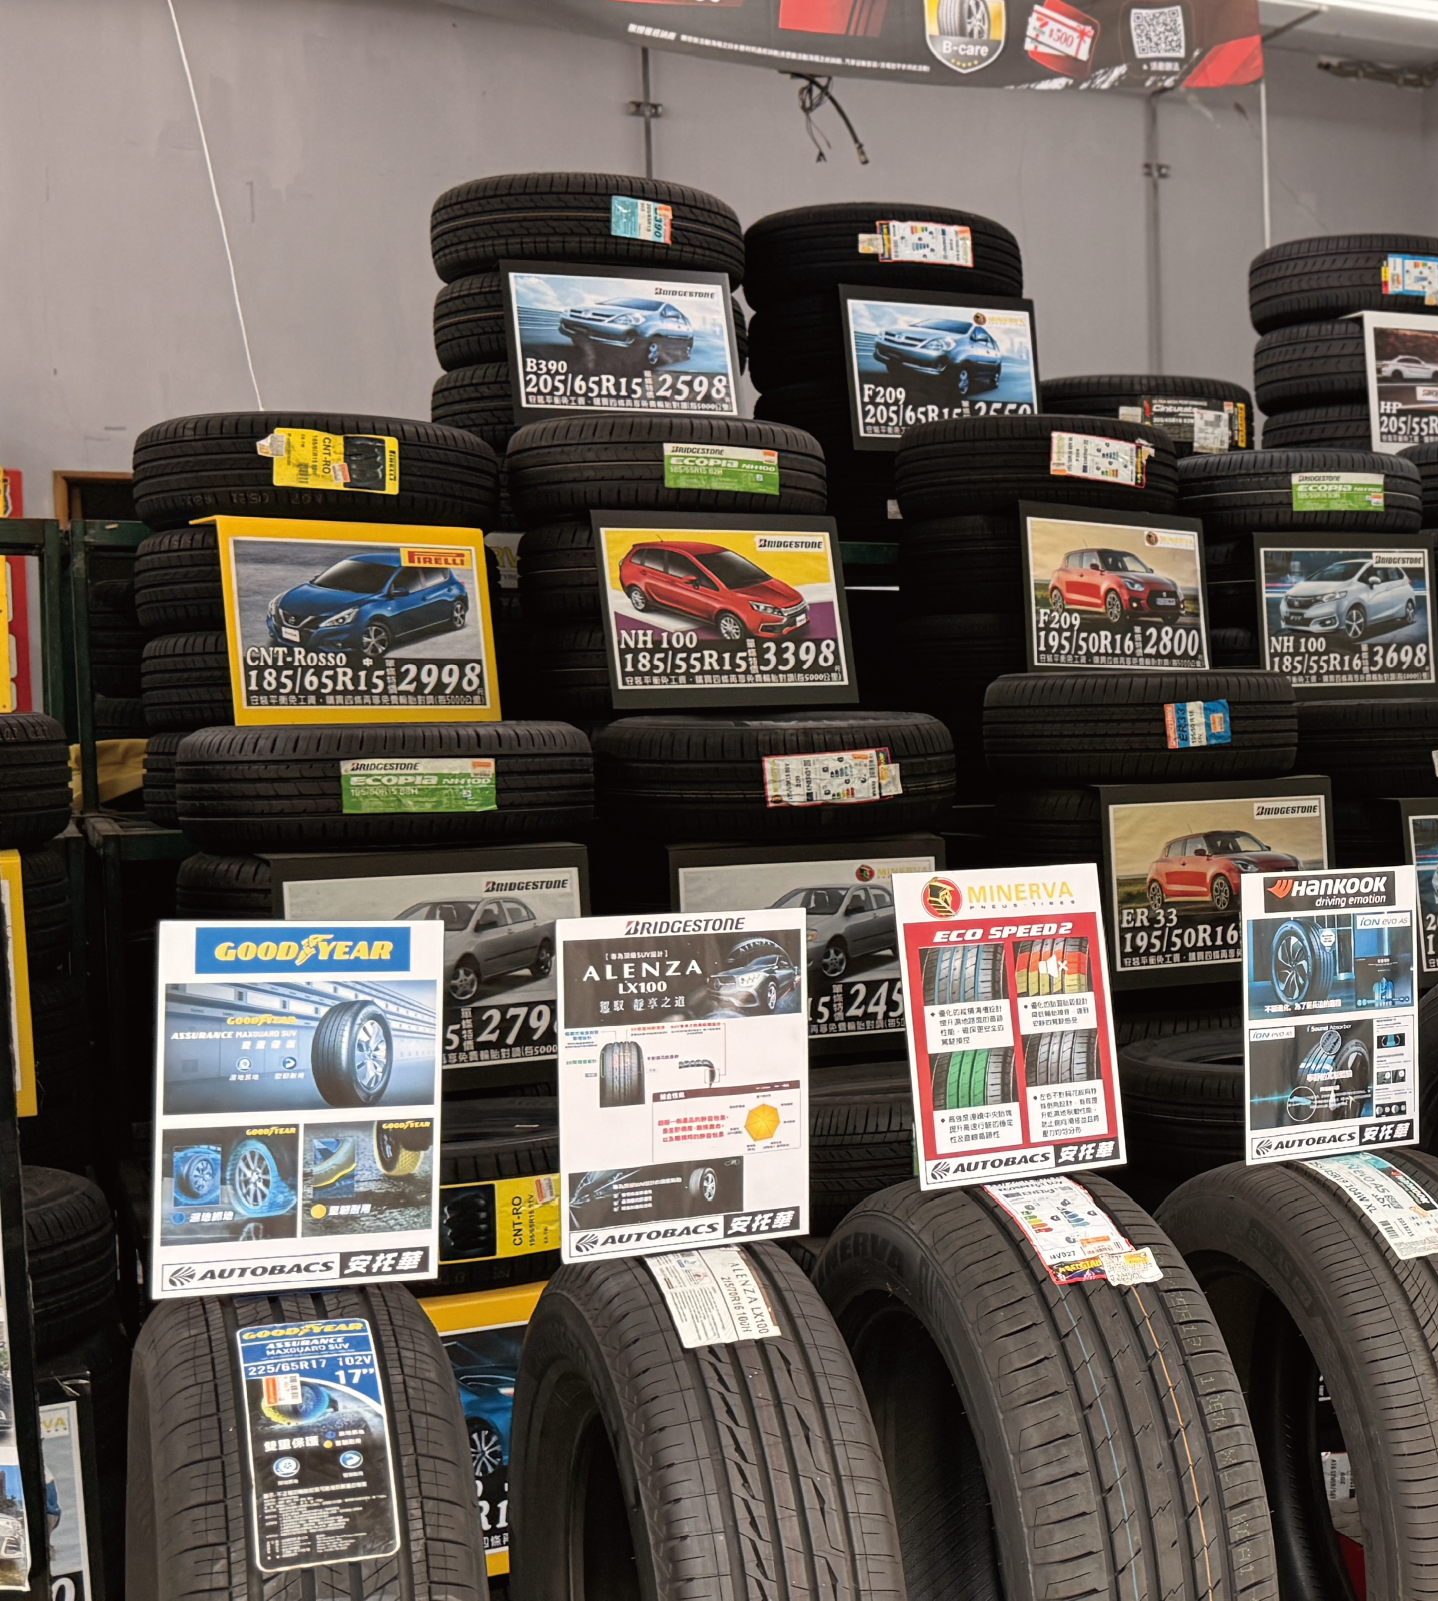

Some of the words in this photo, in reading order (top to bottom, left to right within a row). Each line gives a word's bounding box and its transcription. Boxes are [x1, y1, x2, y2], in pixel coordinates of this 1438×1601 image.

[1047, 27, 1075, 50] $500
[941, 41, 989, 58] B-care
[654, 287, 715, 299] BRIDGESTONE
[525, 358, 567, 373] B390
[525, 373, 643, 398] 205/65R15
[656, 374, 727, 401] 2598
[862, 384, 906, 405] F209
[1379, 401, 1402, 414] HP
[322, 437, 332, 475] CNT-RO
[671, 446, 724, 456] BRIDGESTONE
[741, 463, 775, 472] NH100
[758, 538, 823, 550] BRIDGESTONE
[407, 550, 465, 566] PIRELLI
[1374, 555, 1422, 565] BRIDGESTONE
[1038, 609, 1081, 630] F209
[620, 630, 653, 649] NH
[661, 630, 698, 649] 100
[1038, 629, 1134, 655] 195/50R16
[1144, 626, 1200, 657] 2800
[1270, 636, 1295, 653] NH
[1299, 637, 1326, 653] 100
[246, 646, 347, 667] CNT-Rosso
[624, 650, 748, 674] 185/55R15
[759, 640, 835, 672] 3398
[1273, 653, 1362, 674] 185/55R16
[1370, 643, 1428, 672] 3698
[248, 668, 385, 694] 185/65R15
[398, 662, 482, 694] 2998
[350, 762, 420, 772] BRIDGESTONE
[1255, 804, 1319, 817] BRIDGESTONE
[483, 878, 569, 893] BRIDGESTONE
[967, 881, 1074, 904] MINERVA
[1315, 896, 1347, 909] driving
[1348, 894, 1387, 905] emotion
[624, 917, 746, 936] BRIDGESTONE
[1121, 909, 1151, 928] ER
[1154, 909, 1178, 927] 33
[1398, 917, 1408, 926] AS
[932, 928, 986, 944] ECO
[1123, 924, 1239, 954] 195/50R16
[214, 934, 394, 966] GOODYEAR
[582, 959, 703, 983] ALENZA
[618, 980, 668, 995] LX100
[226, 1014, 297, 1026] GOODYEAR
[460, 1007, 475, 1051] 單條特價
[477, 1004, 558, 1045] 279
[171, 1031, 234, 1040] ASSURANCE
[235, 1031, 280, 1039] MAXGUARD
[245, 1126, 297, 1136] GOODYEAR
[382, 1119, 431, 1130] GOODYEAR
[1274, 1131, 1357, 1151] AUTOBACS
[1362, 1122, 1411, 1143] 安托華
[952, 1151, 1051, 1175] AUTOBACS
[1058, 1140, 1115, 1165] 安托華
[511, 1196, 523, 1246] CNT-RO
[600, 1222, 720, 1247] AUTOBACS
[727, 1210, 795, 1235] 安托華
[199, 1259, 335, 1282] AUTOBACS
[343, 1250, 424, 1275] 安托華
[729, 1262, 759, 1304] ALENZA
[750, 1306, 770, 1334] LX100
[241, 1321, 364, 1341] GOODYEAR
[265, 1336, 345, 1350] ASSURANCE
[265, 1344, 327, 1357] MAXGUARD
[328, 1342, 350, 1352] SUV
[247, 1358, 328, 1377] 225/65R17
[337, 1354, 372, 1367] 102V
